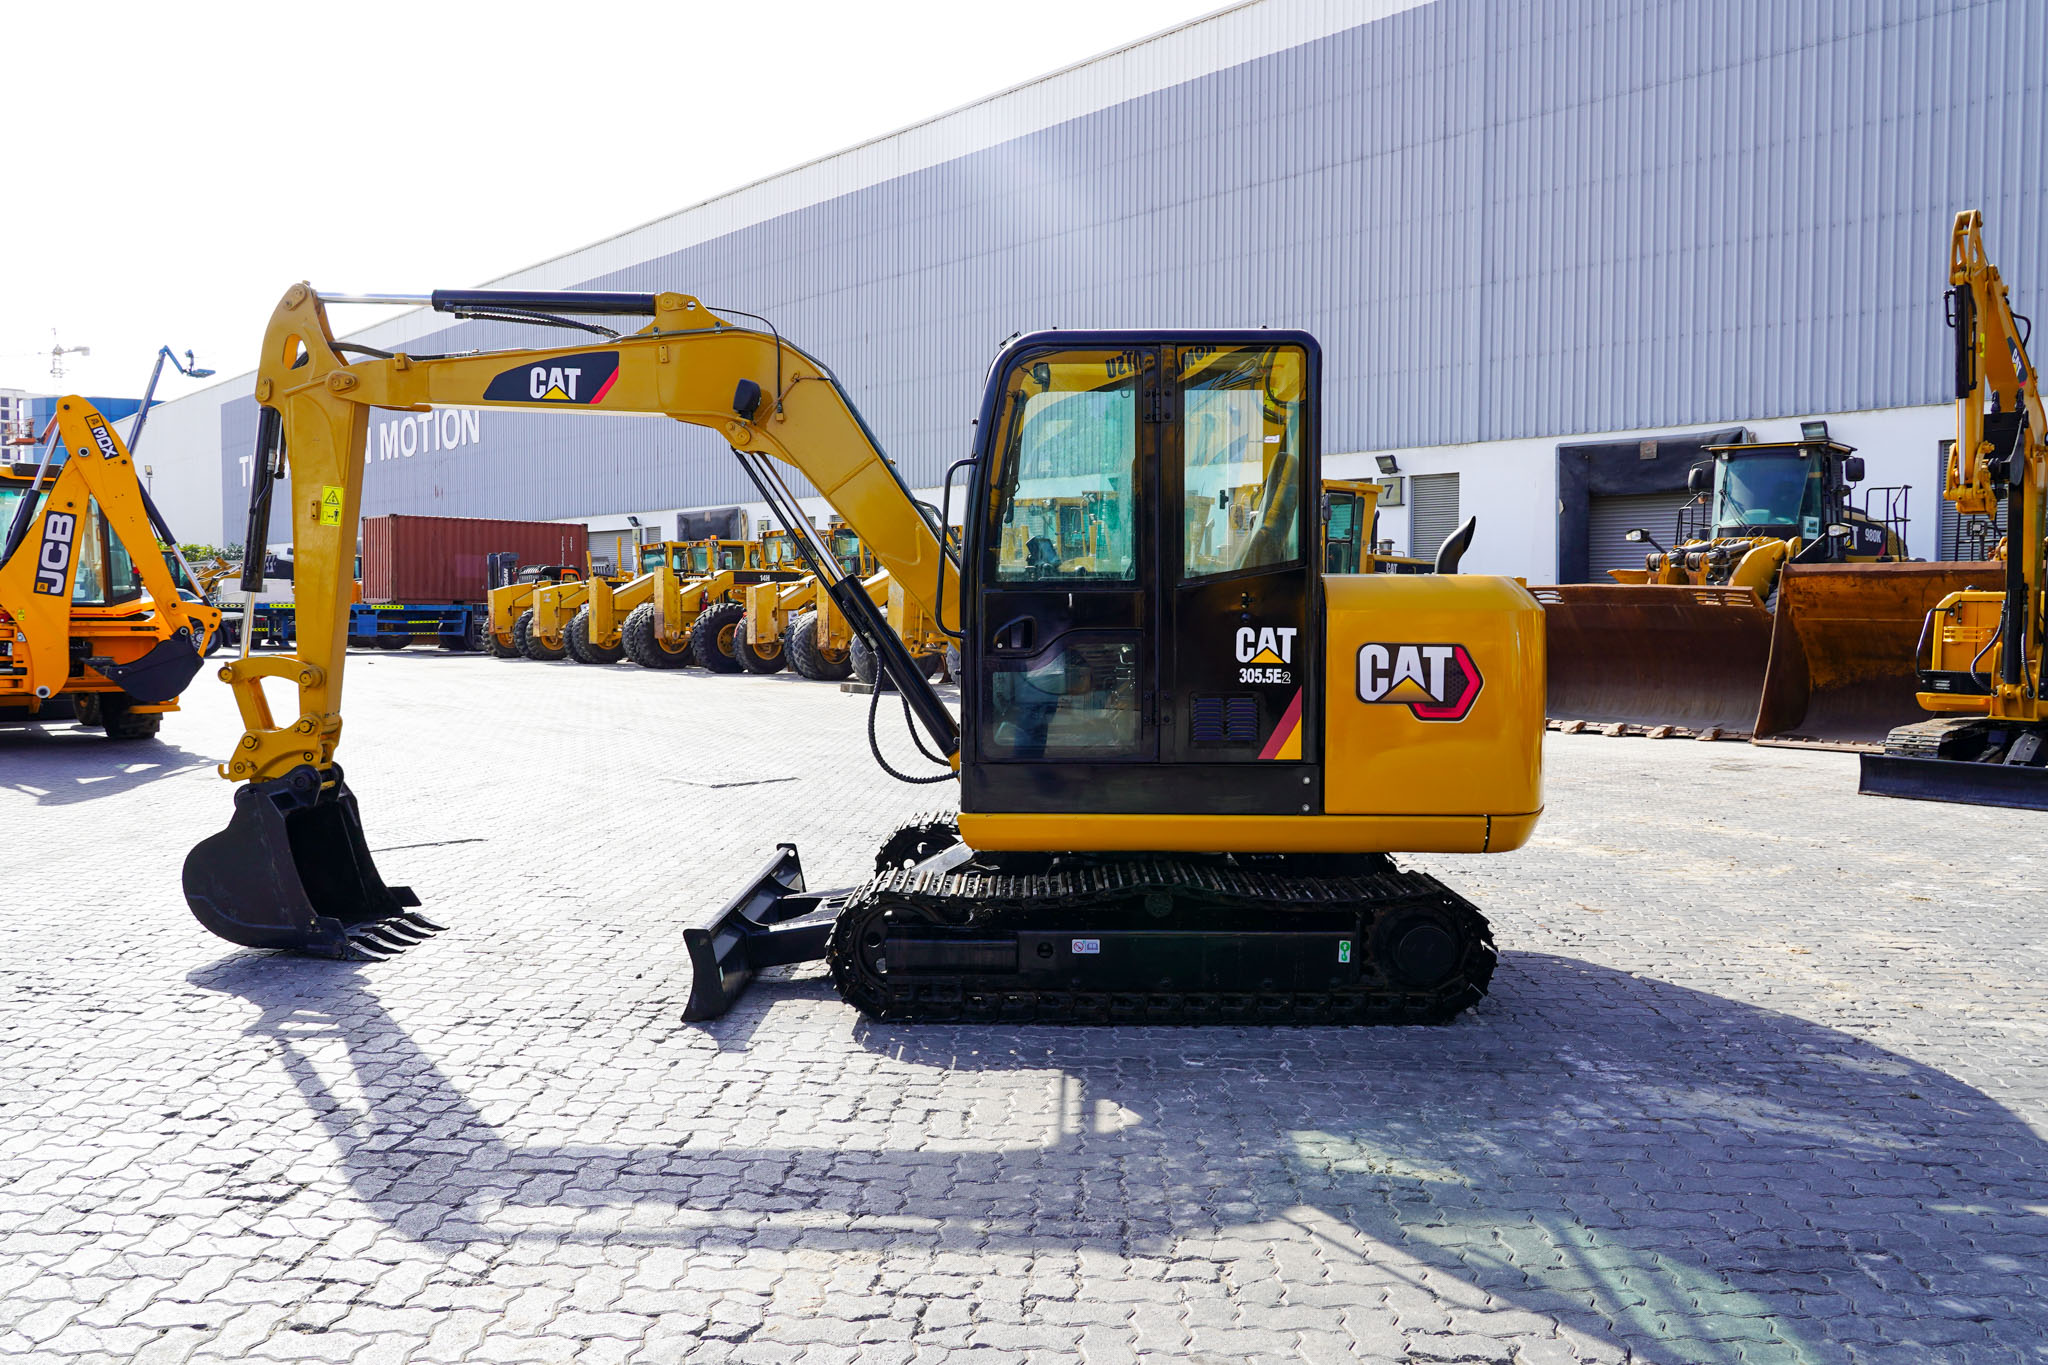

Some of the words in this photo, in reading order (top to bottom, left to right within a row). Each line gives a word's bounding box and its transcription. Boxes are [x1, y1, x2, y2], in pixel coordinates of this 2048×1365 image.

[530, 367, 581, 400] CAT
[93, 427, 118, 458] 3DX
[380, 409, 480, 461] MOTION
[1384, 484, 1394, 499] 7
[1865, 528, 1882, 543] 980K
[39, 514, 73, 593] JCB
[1386, 562, 1398, 574] CAT
[1235, 626, 1297, 664] CAT
[1239, 668, 1291, 684] 305.5E2
[1360, 644, 1452, 702] CAT
